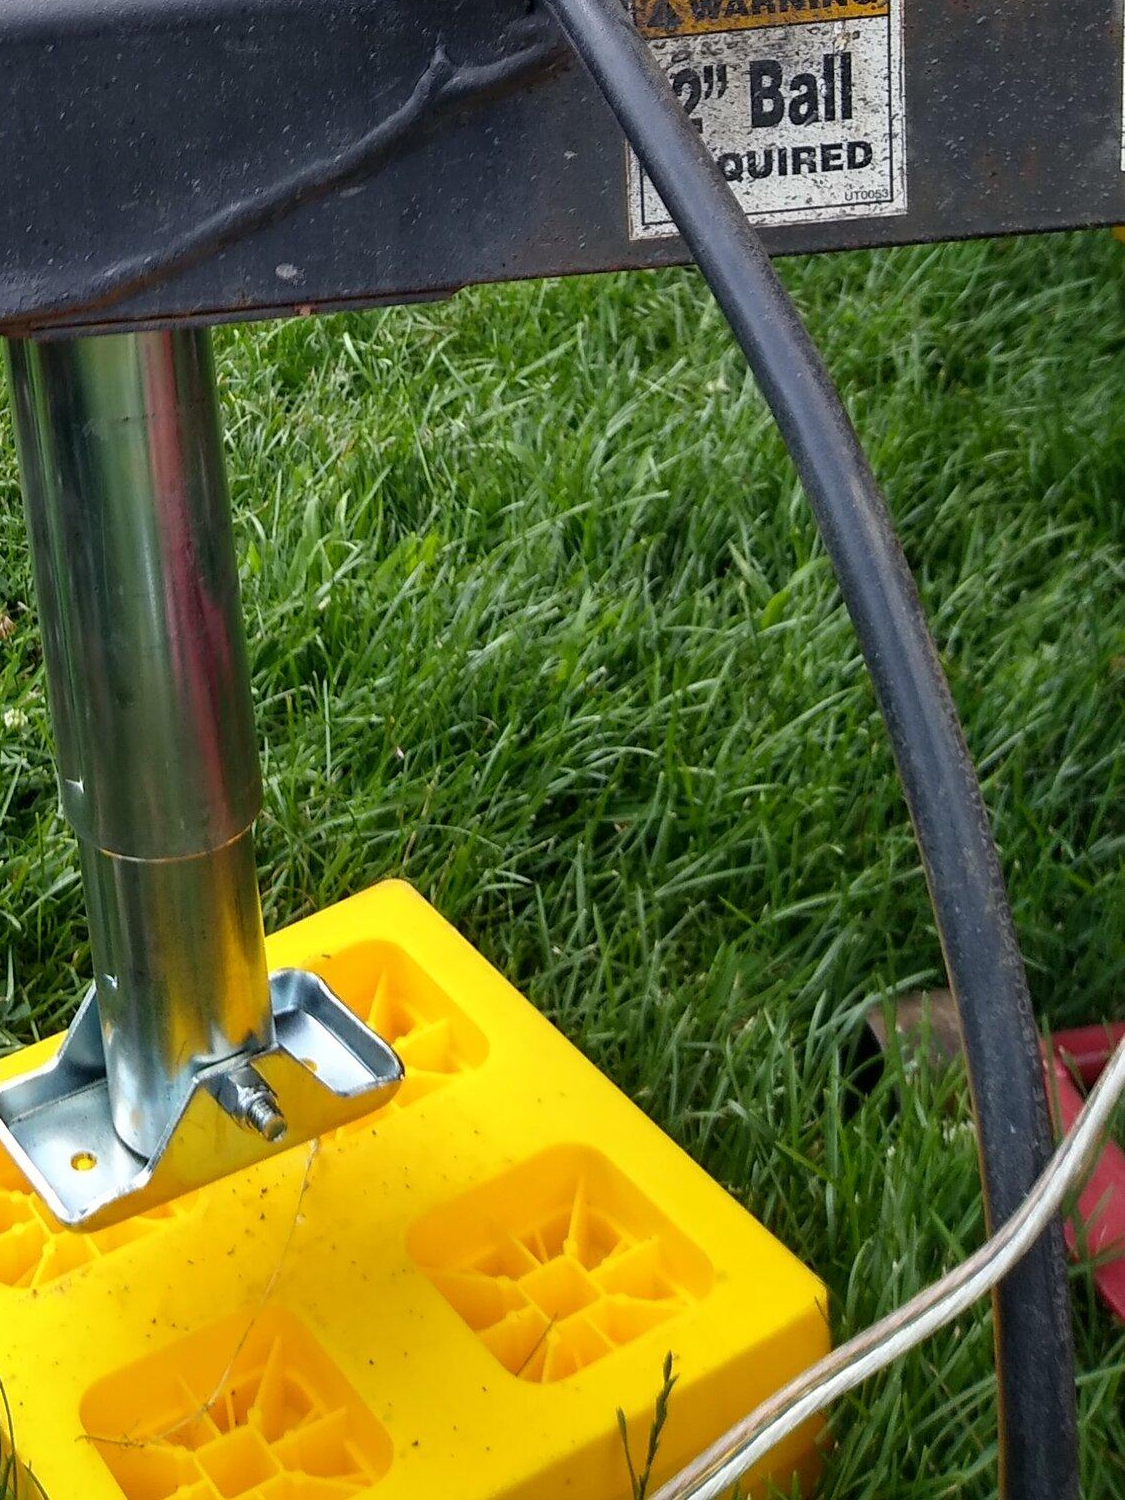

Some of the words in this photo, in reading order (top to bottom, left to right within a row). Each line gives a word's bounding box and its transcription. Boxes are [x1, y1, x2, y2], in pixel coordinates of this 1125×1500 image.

[749, 52, 853, 129] Ball
[717, 140, 873, 182] QUIRED
[844, 189, 889, 202] UT0053
